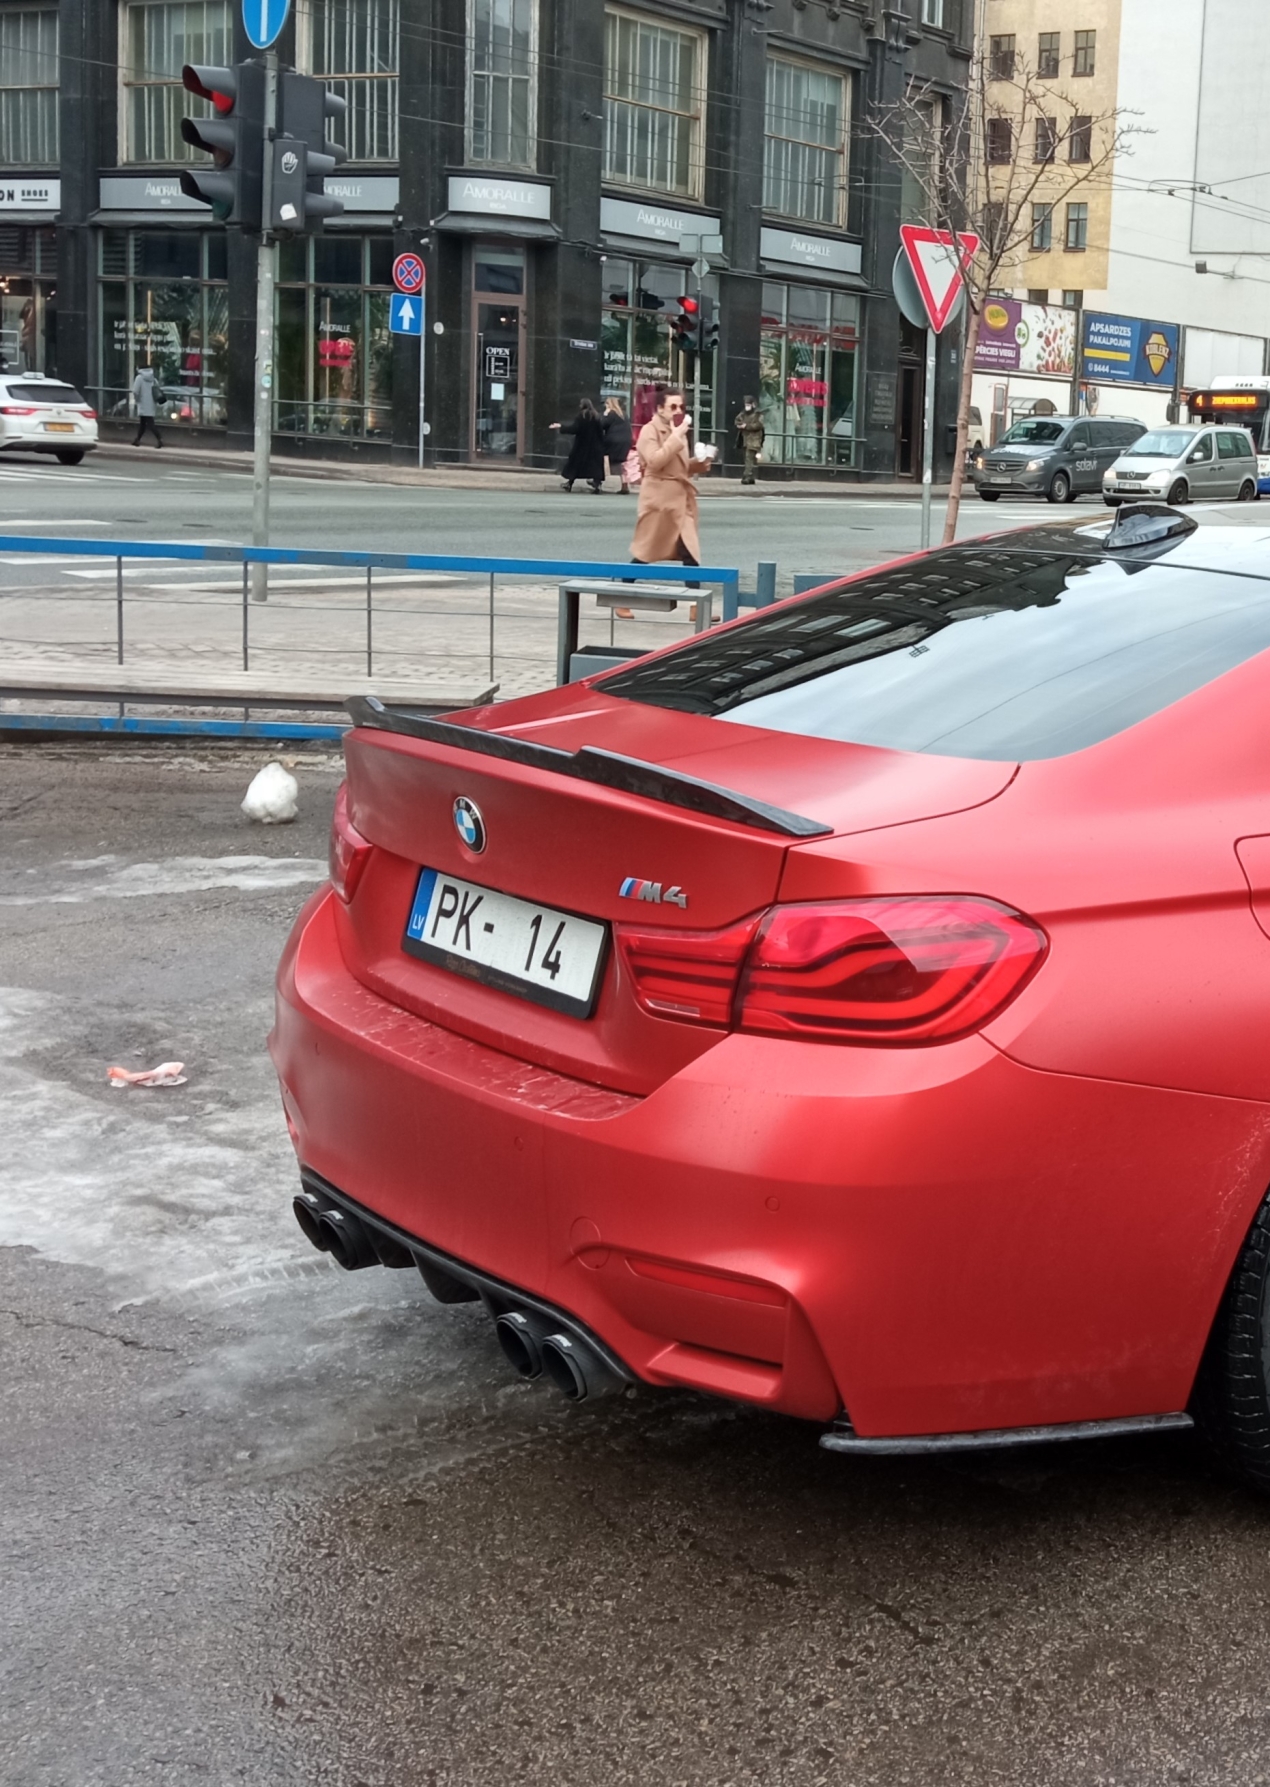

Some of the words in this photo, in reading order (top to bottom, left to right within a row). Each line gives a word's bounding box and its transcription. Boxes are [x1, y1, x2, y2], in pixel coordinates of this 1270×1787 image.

[21, 189, 49, 197] SHOES
[144, 182, 185, 196] AMORALL
[324, 185, 362, 197] MORALLE
[462, 182, 535, 204] AMORALLE
[637, 209, 684, 229] AMORALLE
[791, 237, 831, 256] AMORALLE
[319, 321, 351, 332] AMORALLE
[1090, 322, 1131, 336] APSARDZES
[1089, 335, 1131, 348] PAKALPOJUMI
[486, 347, 510, 355] OPEN
[1196, 395, 1203, 406] 4
[637, 880, 688, 909] M4
[412, 914, 425, 932] LV
[524, 914, 563, 981] 14
